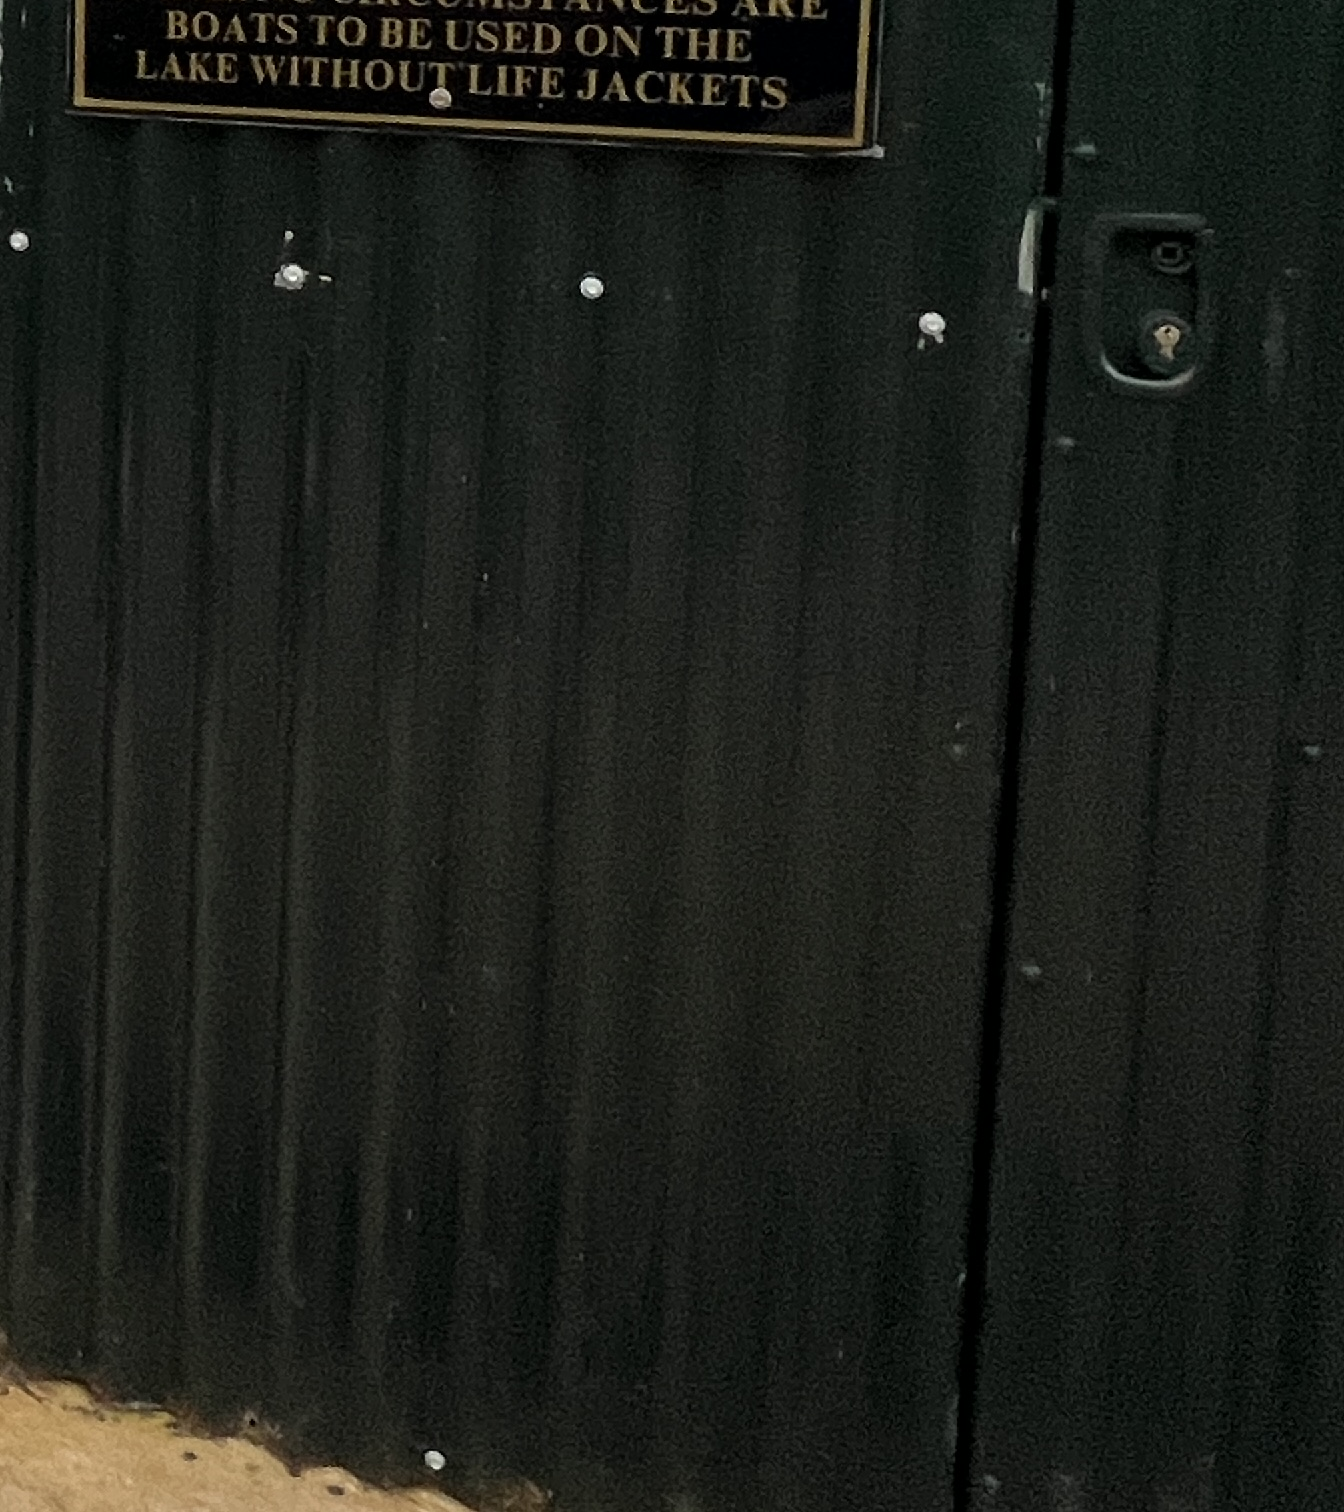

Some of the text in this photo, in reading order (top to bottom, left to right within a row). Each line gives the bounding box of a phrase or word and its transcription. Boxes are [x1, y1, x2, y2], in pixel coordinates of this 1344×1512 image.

[166, 11, 753, 63] BOATS TO BE USED ON THE
[135, 50, 789, 110] LAKE WITHOUT LIFE JACKETS
